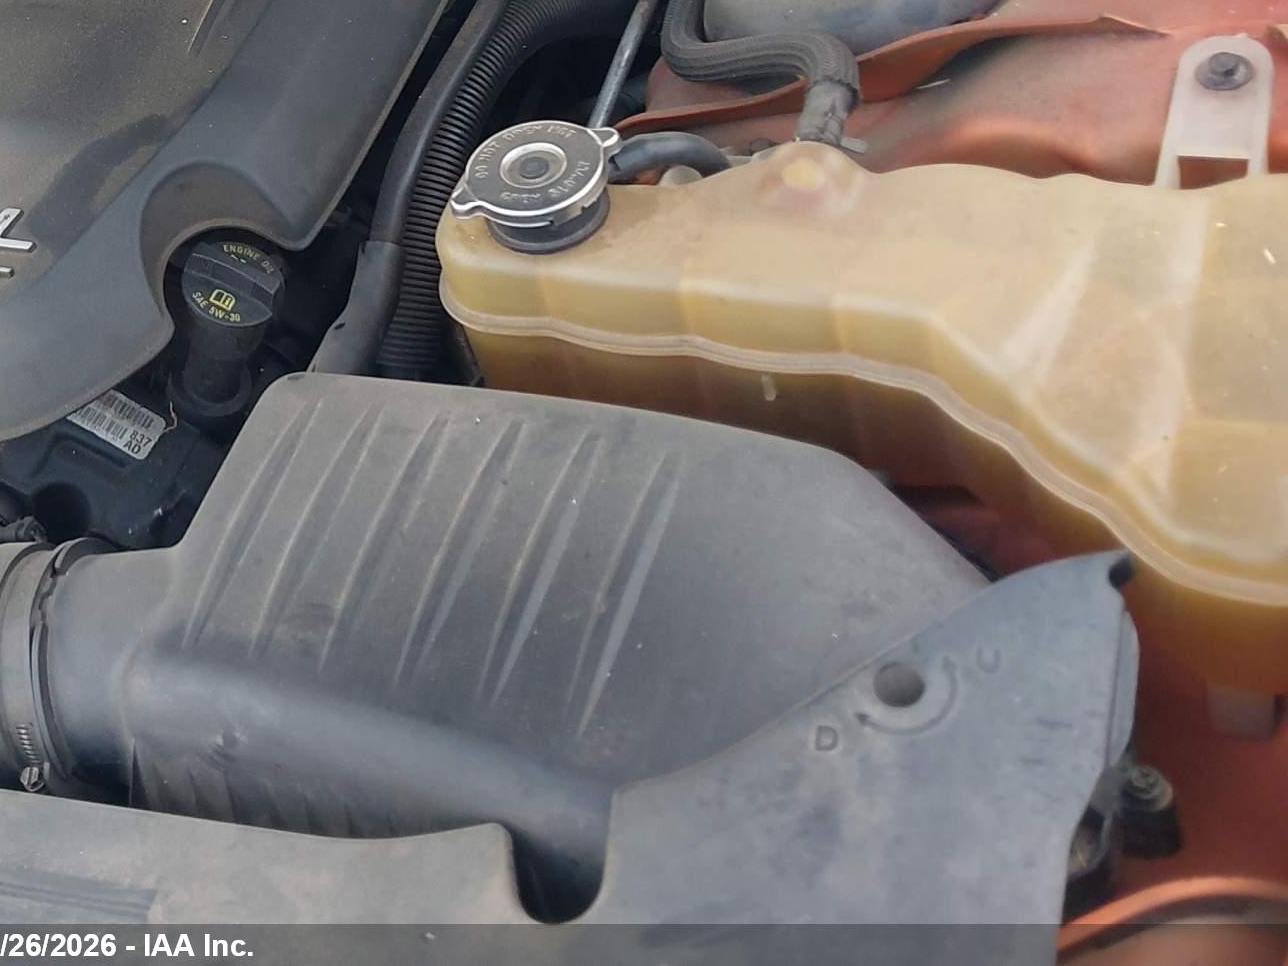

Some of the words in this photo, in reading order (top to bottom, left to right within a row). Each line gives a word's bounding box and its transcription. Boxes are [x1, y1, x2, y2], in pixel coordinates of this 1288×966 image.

[222, 243, 262, 262] ENGINE
[261, 257, 276, 275] OIL
[192, 291, 209, 310] SAE
[208, 306, 241, 323] 5W-30
[123, 440, 142, 455] AD
[129, 428, 152, 447] 837
[814, 724, 839, 752] D
